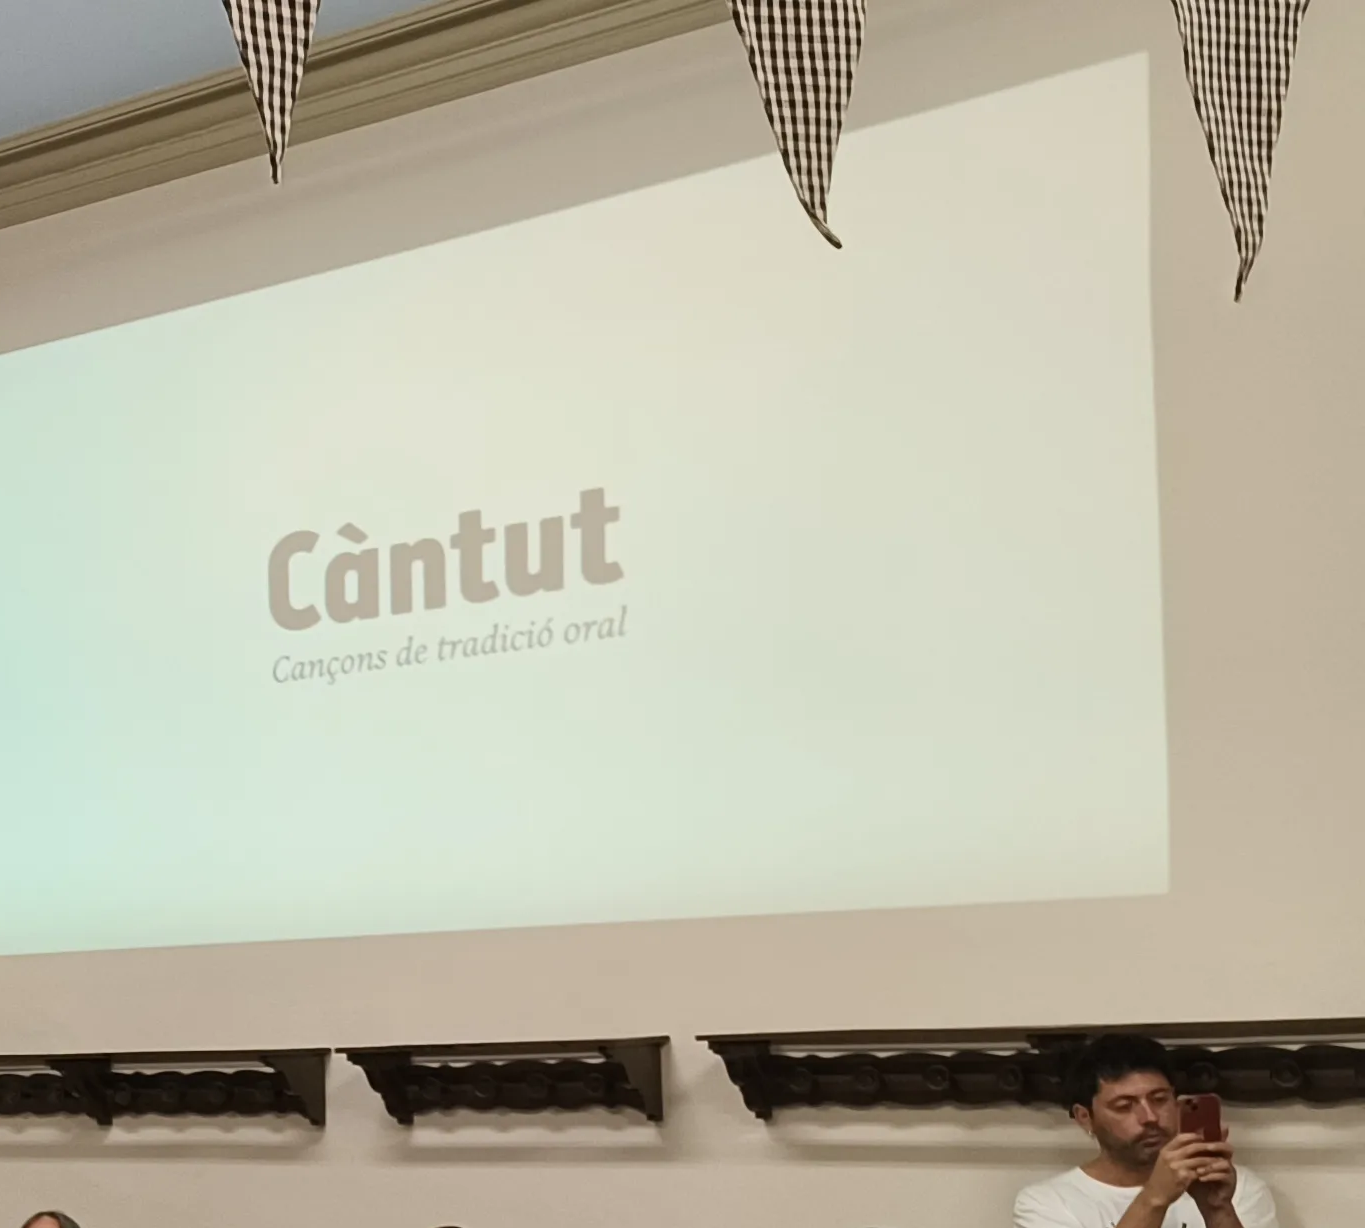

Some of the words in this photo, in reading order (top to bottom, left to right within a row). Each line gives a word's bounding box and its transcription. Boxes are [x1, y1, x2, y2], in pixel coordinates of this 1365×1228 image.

[267, 487, 624, 630] Càntut
[272, 648, 388, 685] Cançons
[396, 635, 428, 668] de
[436, 617, 554, 662] tradició
[563, 605, 628, 645] oral
